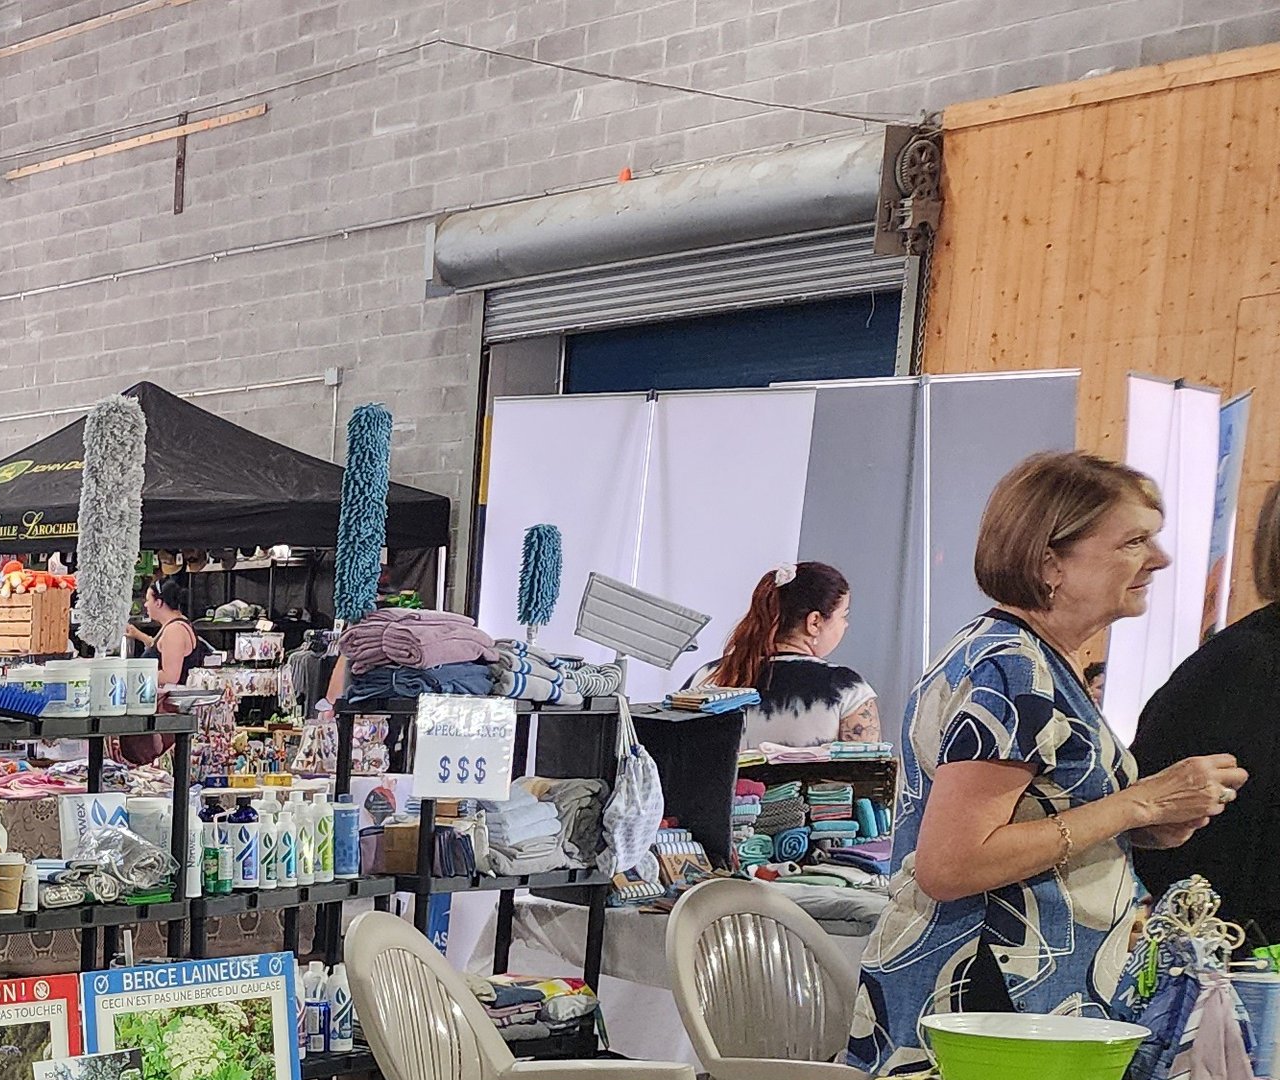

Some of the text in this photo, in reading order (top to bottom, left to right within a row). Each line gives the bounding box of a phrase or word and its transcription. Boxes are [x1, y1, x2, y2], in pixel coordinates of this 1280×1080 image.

[122, 957, 259, 990] BERCE LAINEUSE
[101, 980, 281, 1009] CECI N'EST PAS UNE BERCE DU CAUCASE
[14, 1004, 62, 1018] TOUCHER
